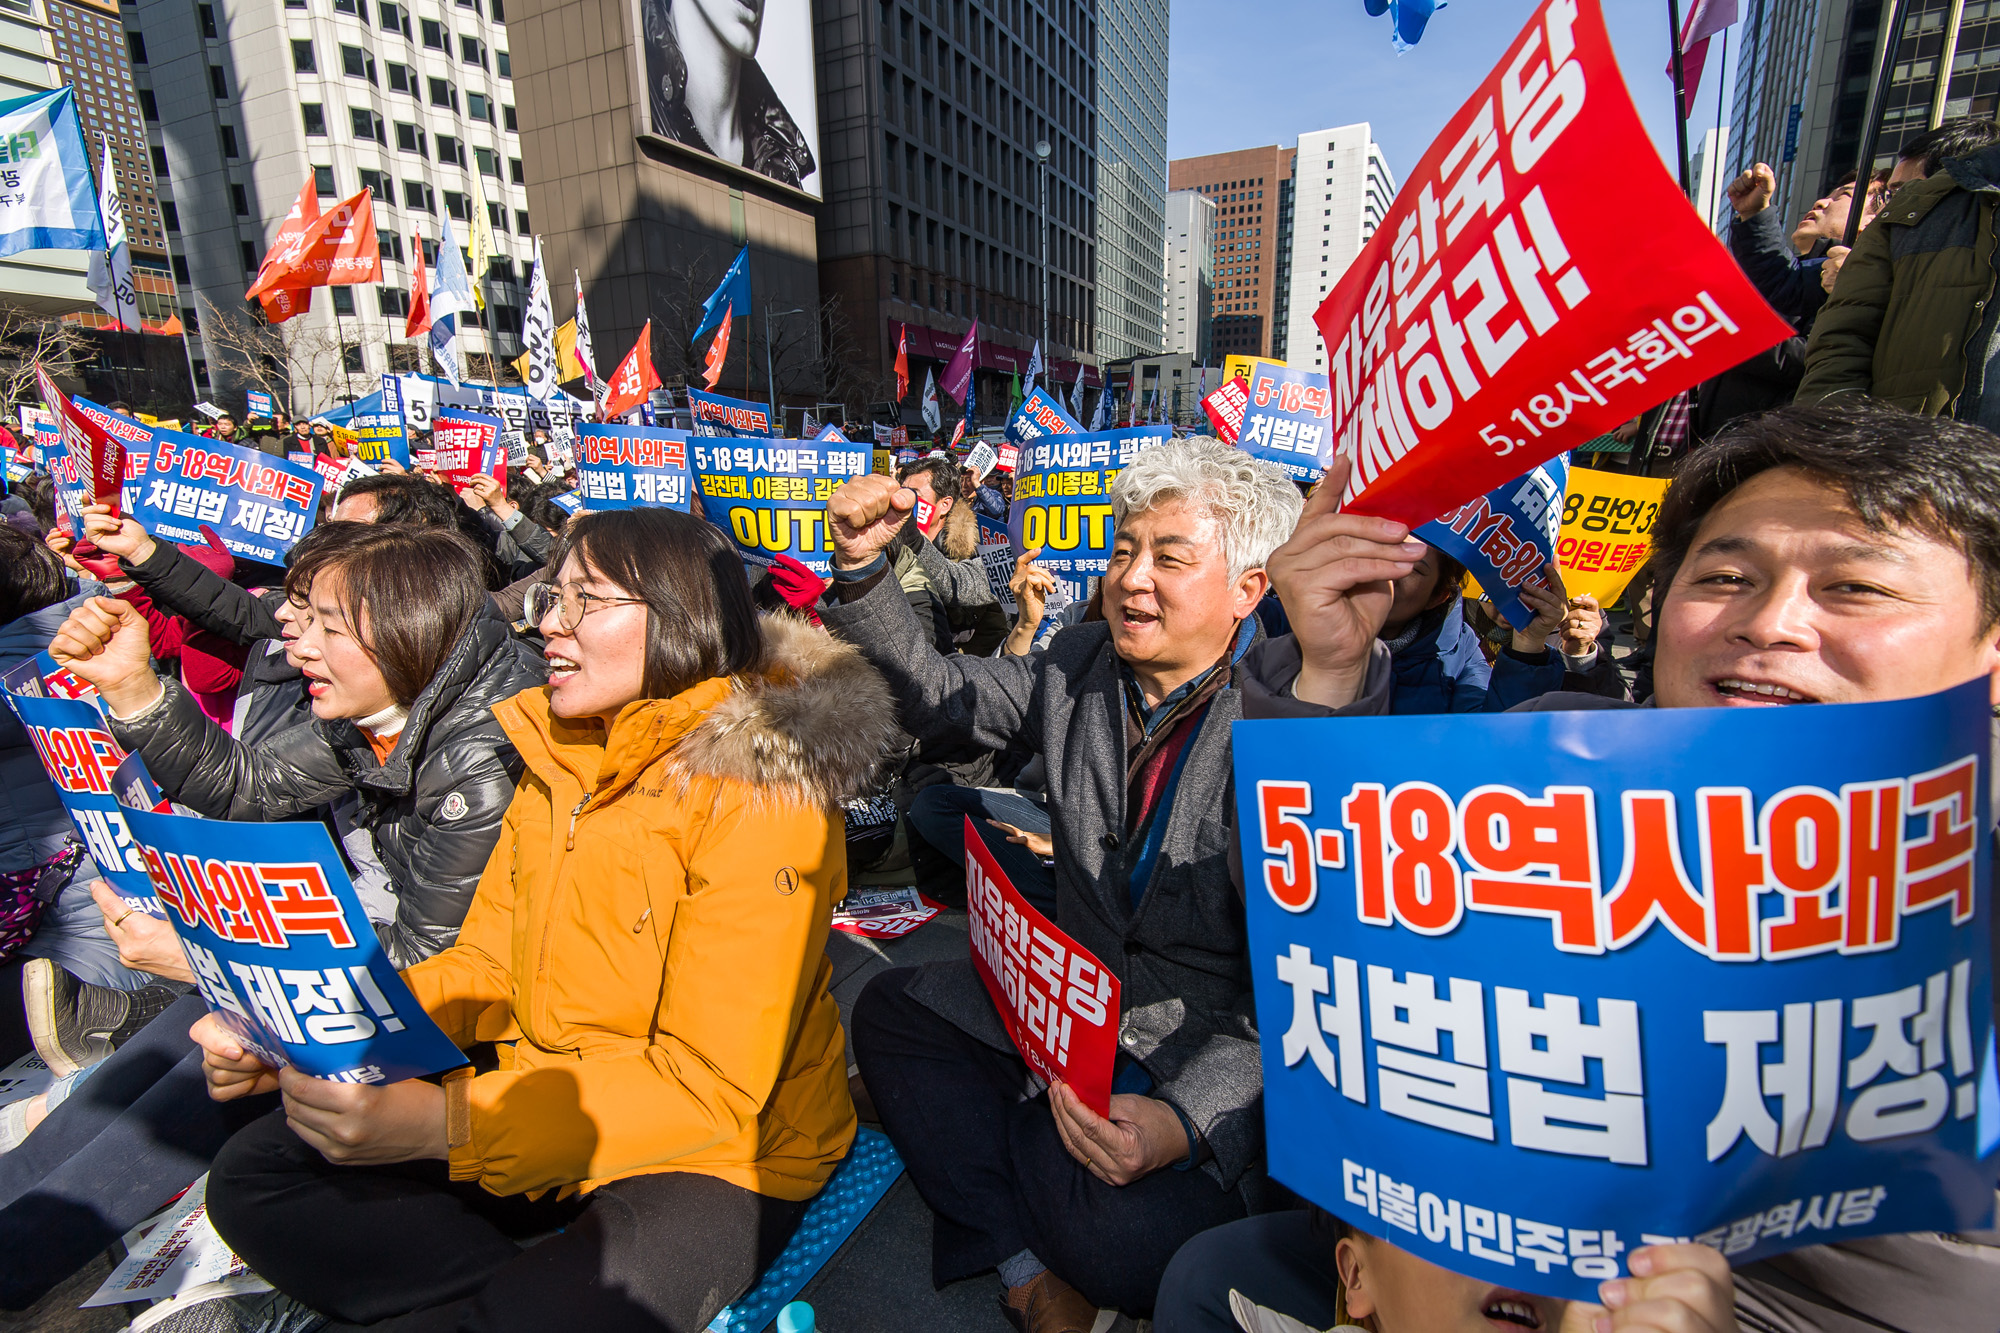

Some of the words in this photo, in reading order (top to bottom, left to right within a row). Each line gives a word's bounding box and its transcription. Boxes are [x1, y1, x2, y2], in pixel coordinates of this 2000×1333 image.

[1332, 0, 1587, 433] 자유한국당
[1478, 291, 1741, 457] 5.18시국회의
[689, 395, 770, 434] 5·18역사왜곡
[1245, 413, 1324, 457] 처벌법
[154, 441, 316, 511] 5·18역사왜곡
[358, 441, 391, 461] OUT!
[575, 434, 686, 470] 5·18역사왜곡
[1048, 470, 1103, 497] 이종명,
[144, 478, 229, 524] 처벌법
[231, 499, 306, 544] 제정!
[577, 469, 628, 501] 처벌법
[632, 473, 686, 504] 제정!
[700, 474, 752, 500] 김진태,
[752, 476, 812, 503] 이종명,
[1581, 496, 1645, 535] 망언
[1556, 538, 1609, 573] 의원
[1257, 753, 1979, 962] 5·18역사왜곡
[966, 849, 1112, 1027] 자유한국당
[228, 960, 406, 1045] 제정!
[969, 907, 1074, 1068] 해체하라!
[1276, 942, 1651, 1166] 처벌법
[1703, 959, 1979, 1162] 제정!
[1342, 1157, 1625, 1282] 더불어민주당
[1640, 1186, 1888, 1257] 광역시당
